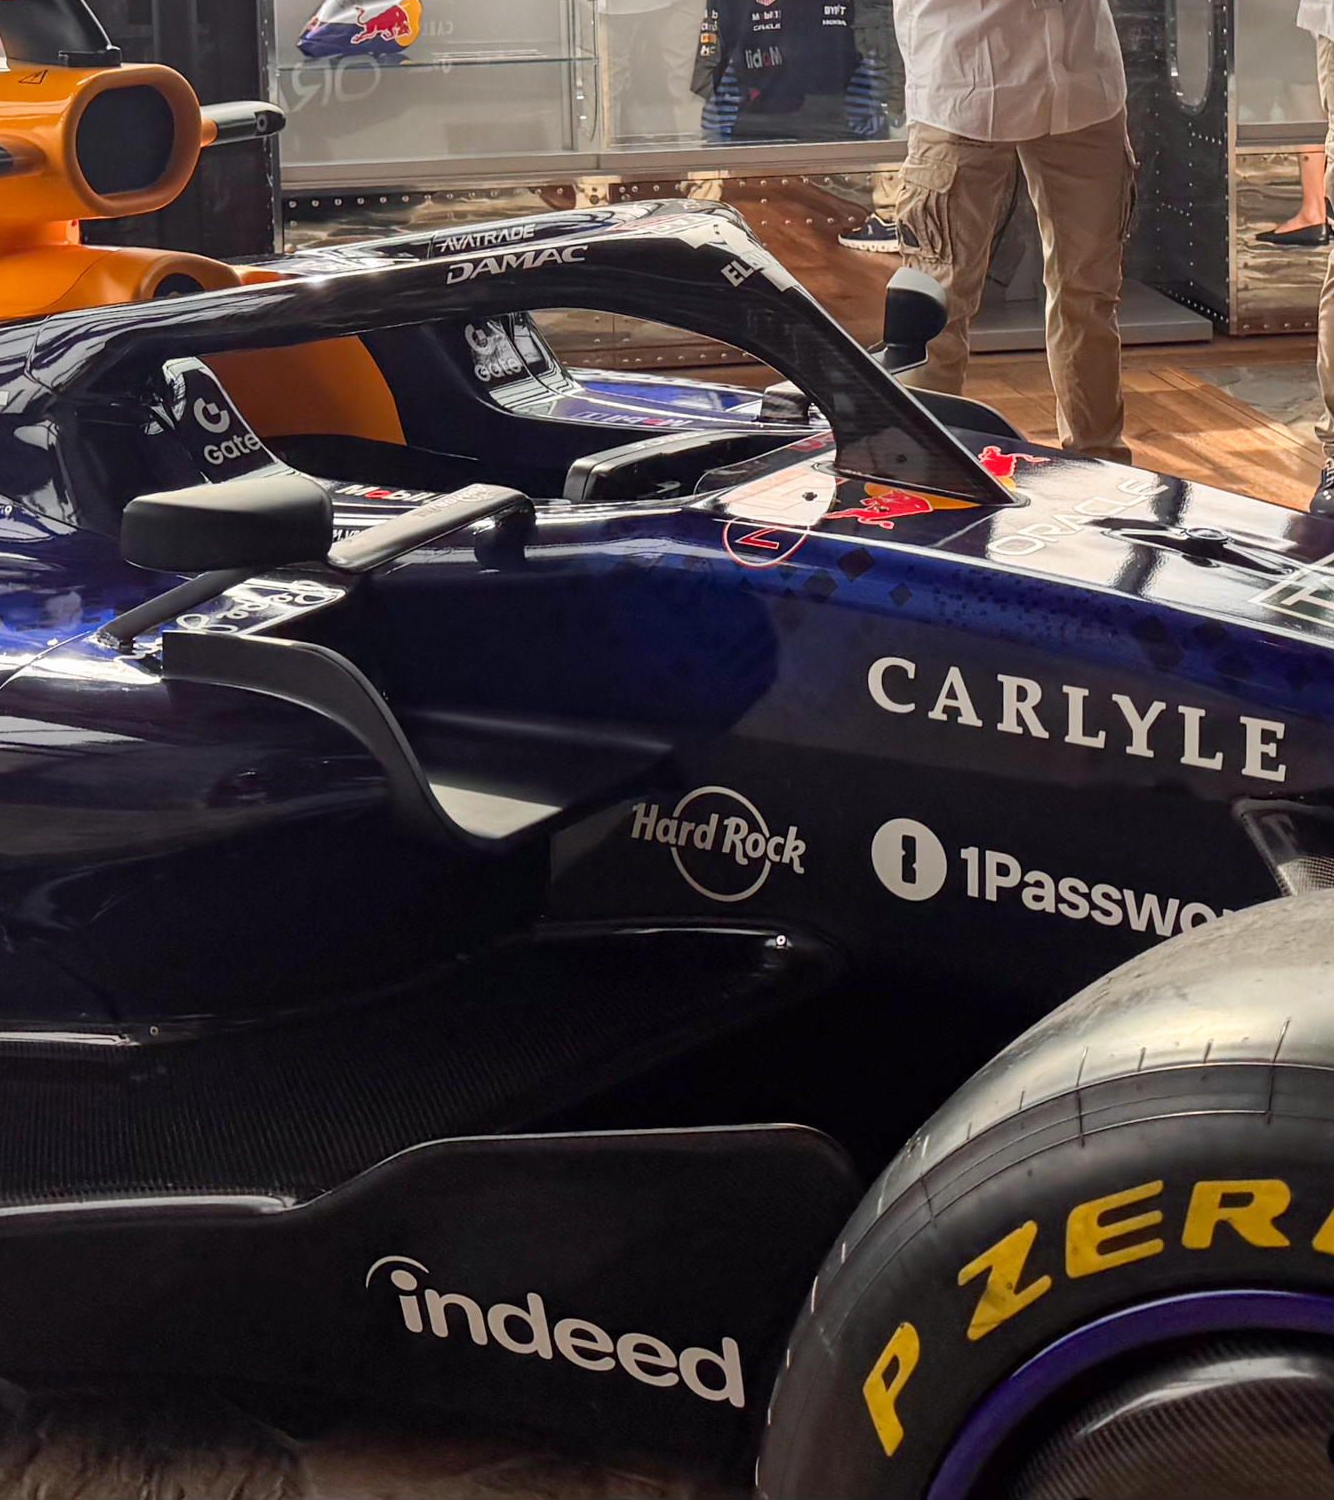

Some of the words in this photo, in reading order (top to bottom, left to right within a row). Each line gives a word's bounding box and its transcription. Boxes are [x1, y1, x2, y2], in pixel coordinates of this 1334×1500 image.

[436, 224, 535, 253] AVATRADE
[446, 245, 588, 285] DAMAC
[203, 432, 264, 466] Gate
[334, 484, 435, 502] Mobil
[986, 477, 1169, 557] ORACLE
[867, 656, 1287, 783] CARLYLE
[631, 803, 719, 851] Hard
[721, 816, 806, 874] Rock
[960, 845, 1241, 937] 1Passwo
[379, 1265, 746, 1408] indeed
[863, 1322, 920, 1456] P
